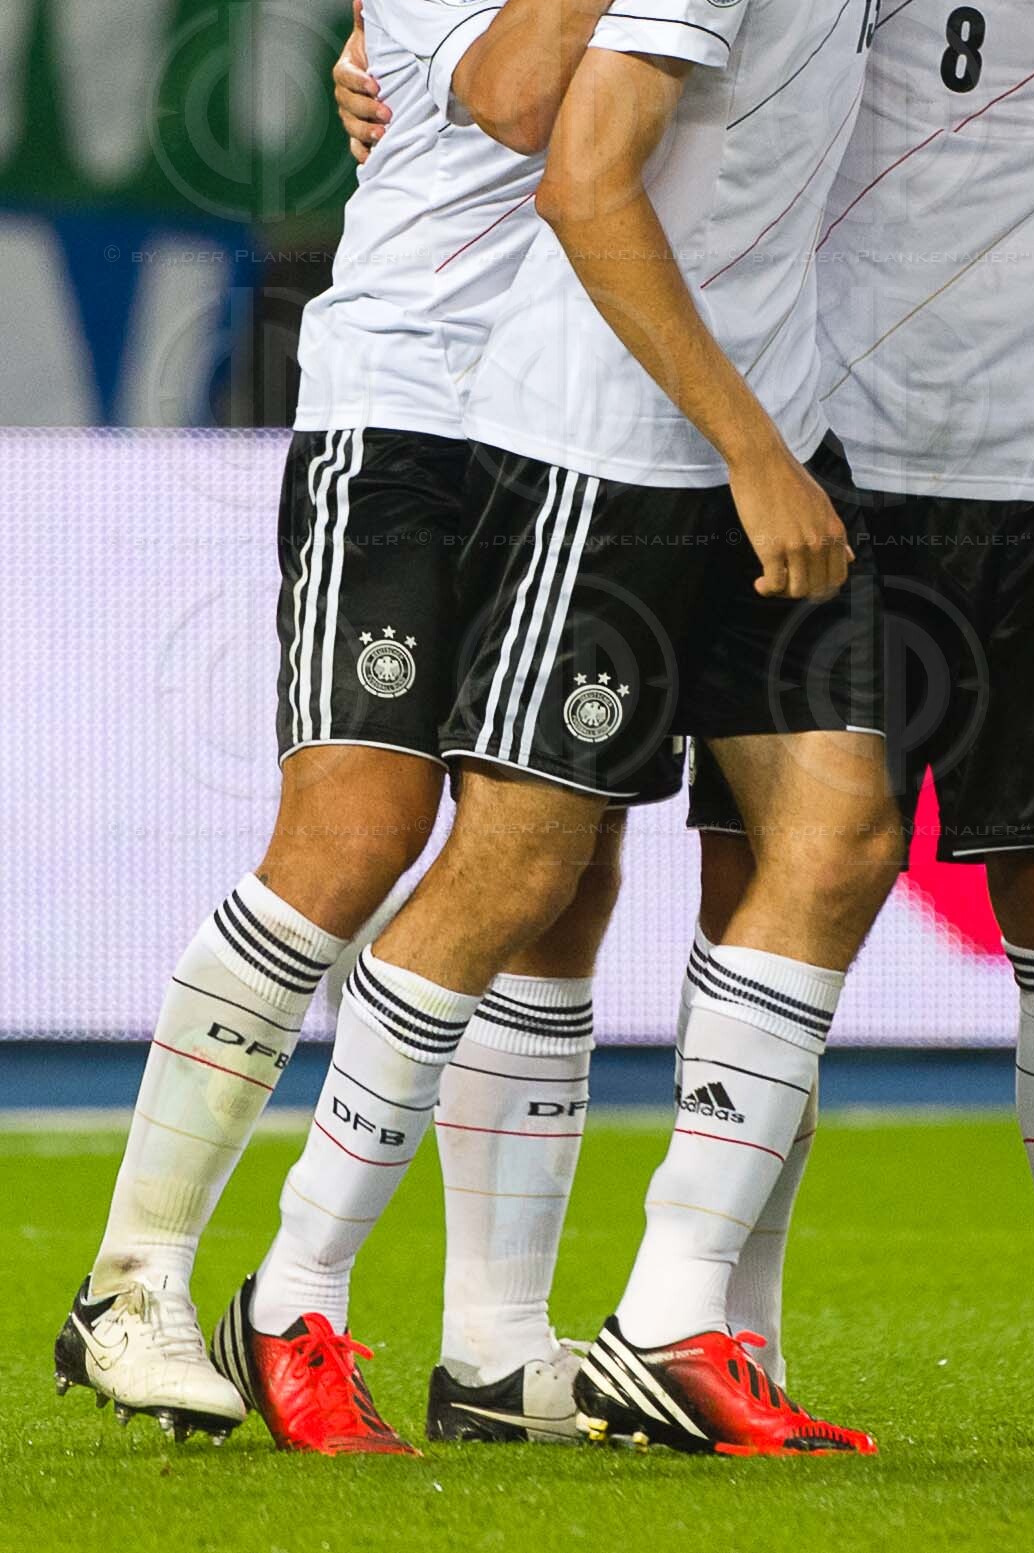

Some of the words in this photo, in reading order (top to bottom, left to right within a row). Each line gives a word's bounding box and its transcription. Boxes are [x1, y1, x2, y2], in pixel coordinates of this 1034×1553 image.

[940, 6, 986, 93] 8
[207, 1022, 290, 1070] DFB
[332, 1096, 406, 1146] DFB
